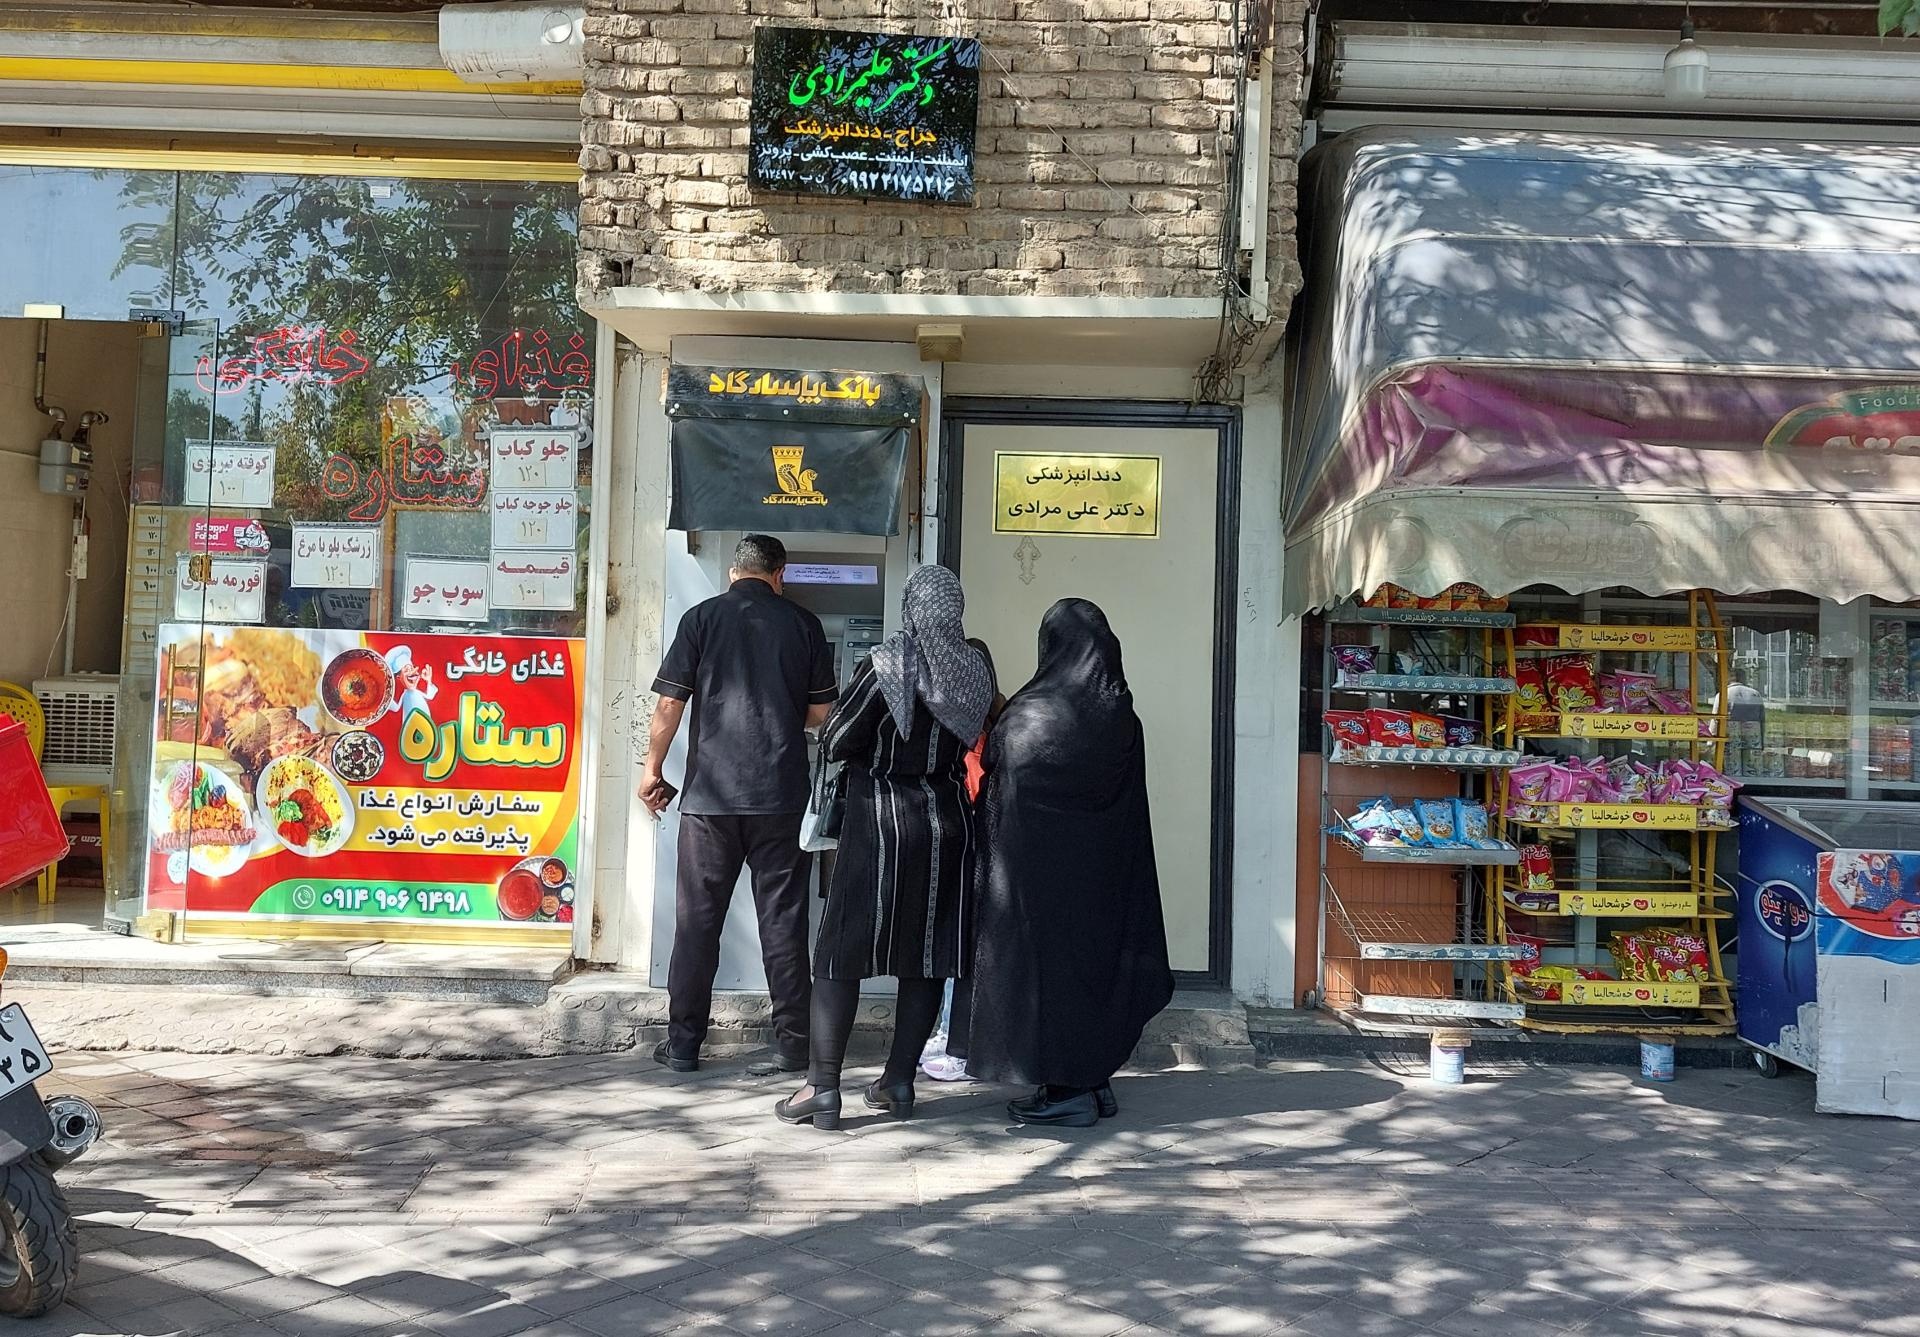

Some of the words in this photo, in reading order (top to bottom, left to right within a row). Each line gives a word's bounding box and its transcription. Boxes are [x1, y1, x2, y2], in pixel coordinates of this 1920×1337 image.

[874, 40, 952, 113] دکتر
[784, 121, 881, 142] دندانپزشک
[895, 127, 937, 147] جراح
[1858, 395, 1907, 409] Food
[497, 440, 535, 460] کباب
[540, 439, 569, 462] چلو
[192, 454, 234, 474] تبریزی
[237, 454, 269, 475] کوفته
[322, 437, 489, 521] ستاره
[1026, 467, 1122, 487] دندانپزشکی
[495, 497, 519, 514] کباب
[522, 501, 551, 515] جوجه
[554, 497, 573, 515] چلو
[1008, 500, 1062, 518] مرادی
[1067, 501, 1099, 520] علی
[1104, 503, 1145, 520] دکتر
[297, 534, 316, 558] مرغ
[319, 536, 325, 557] با
[327, 536, 340, 558] پلو
[342, 537, 371, 558] زرشک
[223, 569, 260, 592] قورمه
[410, 584, 436, 604] جو
[442, 585, 484, 607] سوپ
[446, 646, 506, 680] خانگی
[512, 652, 565, 682] غذای
[402, 691, 565, 780] ستاره
[360, 790, 396, 809] غذا
[400, 794, 452, 818] انواع
[458, 793, 540, 817] سفارش
[421, 829, 446, 847] می
[453, 828, 529, 853] پذیرفته
[321, 887, 369, 910] ۰۹۱۴
[375, 888, 410, 911] ۹۰۶
[416, 890, 471, 912] ۹۴۹۸
